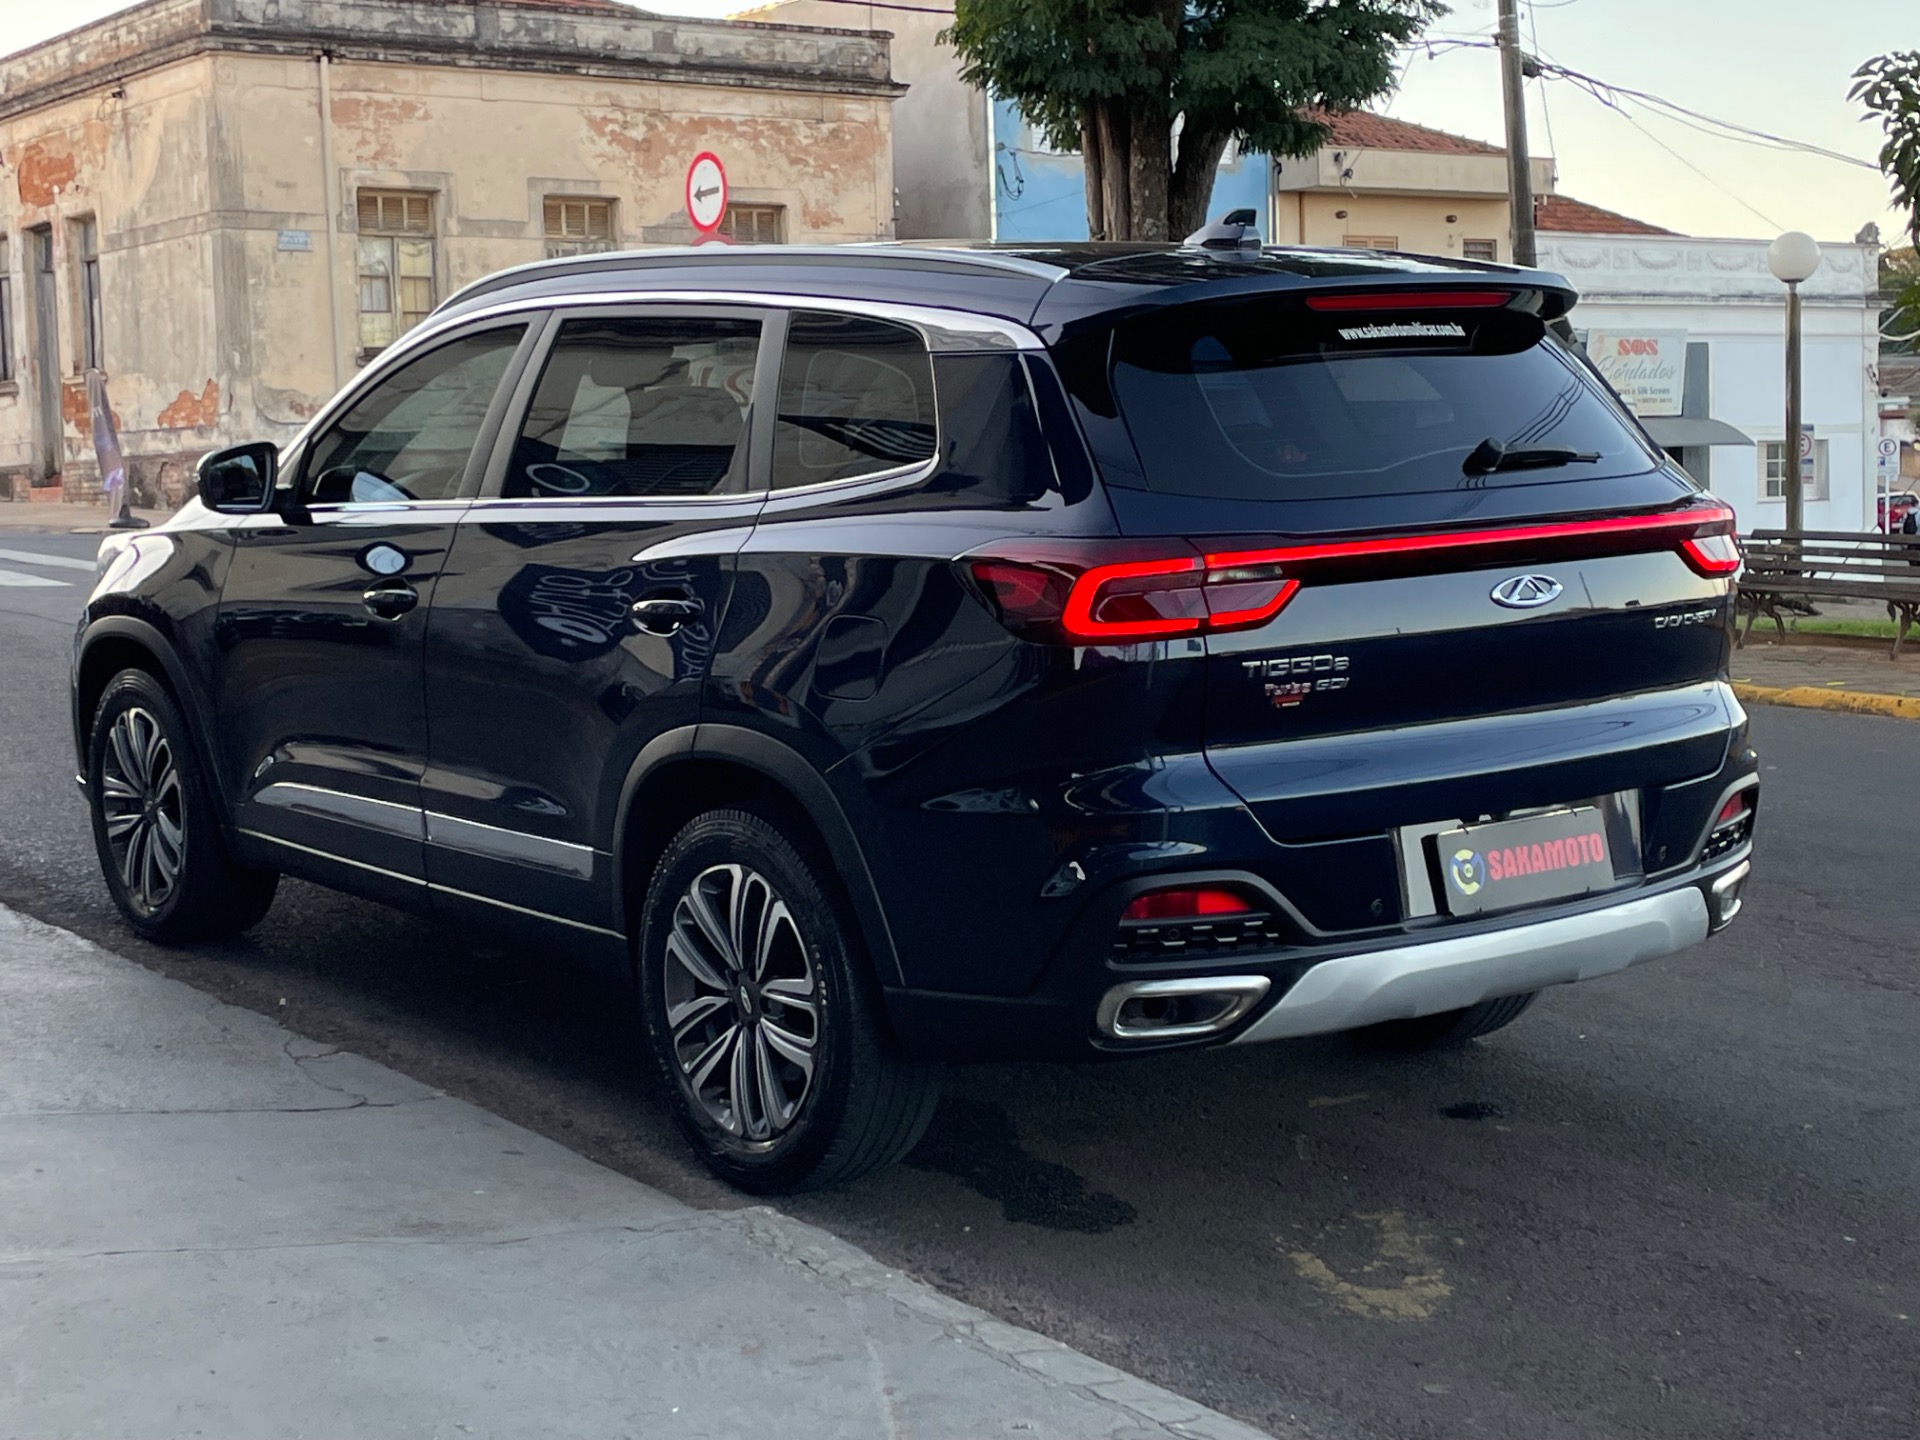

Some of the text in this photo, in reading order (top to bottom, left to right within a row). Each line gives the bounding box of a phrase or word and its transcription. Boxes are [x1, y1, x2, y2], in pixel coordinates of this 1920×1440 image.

[1617, 339, 1659, 356] SOS
[1884, 443, 1891, 452] E
[1487, 832, 1605, 881] SAKAMOTO
